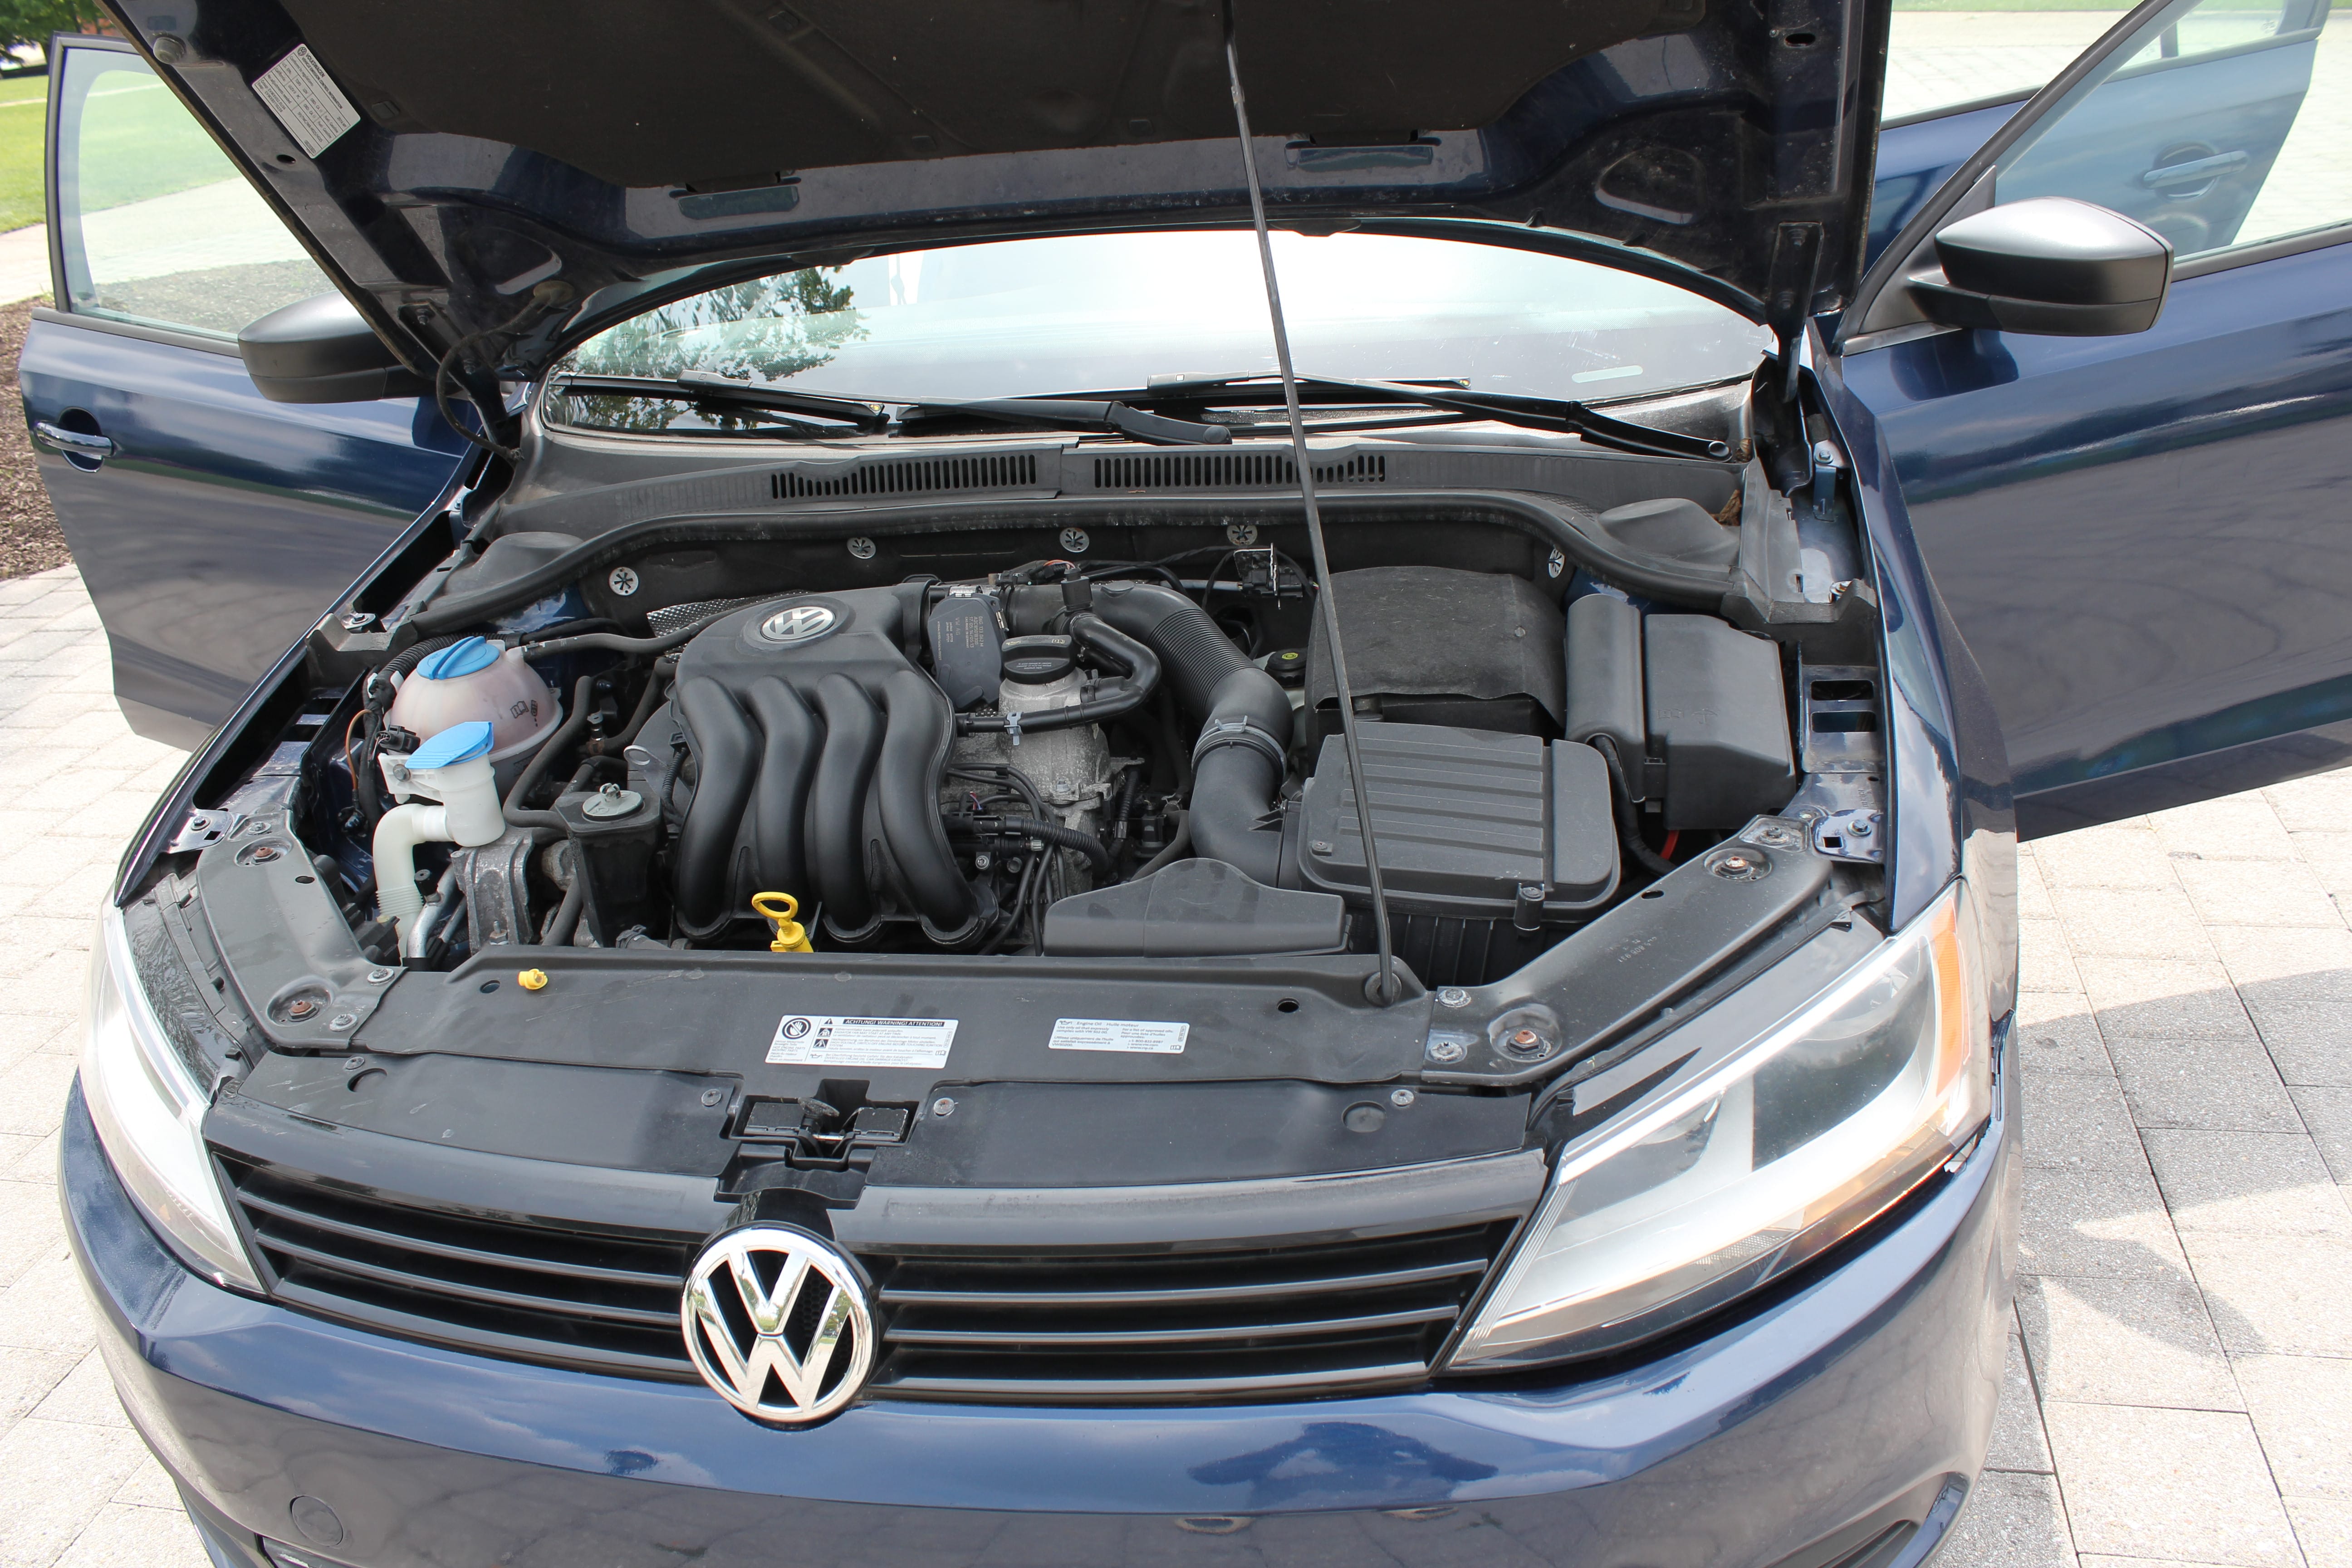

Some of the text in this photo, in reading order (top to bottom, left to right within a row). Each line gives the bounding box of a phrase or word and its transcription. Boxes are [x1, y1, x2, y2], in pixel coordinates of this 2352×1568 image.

[305, 53, 325, 78] VOLKSWAGEN
[301, 57, 343, 109] VEHICLE EMISSION CONTROL INFORMATION
[322, 127, 332, 139] Gasoline
[329, 122, 339, 133] Gasoline
[766, 608, 829, 637] VW
[955, 617, 961, 636] VW AG
[690, 1237, 860, 1415] VW
